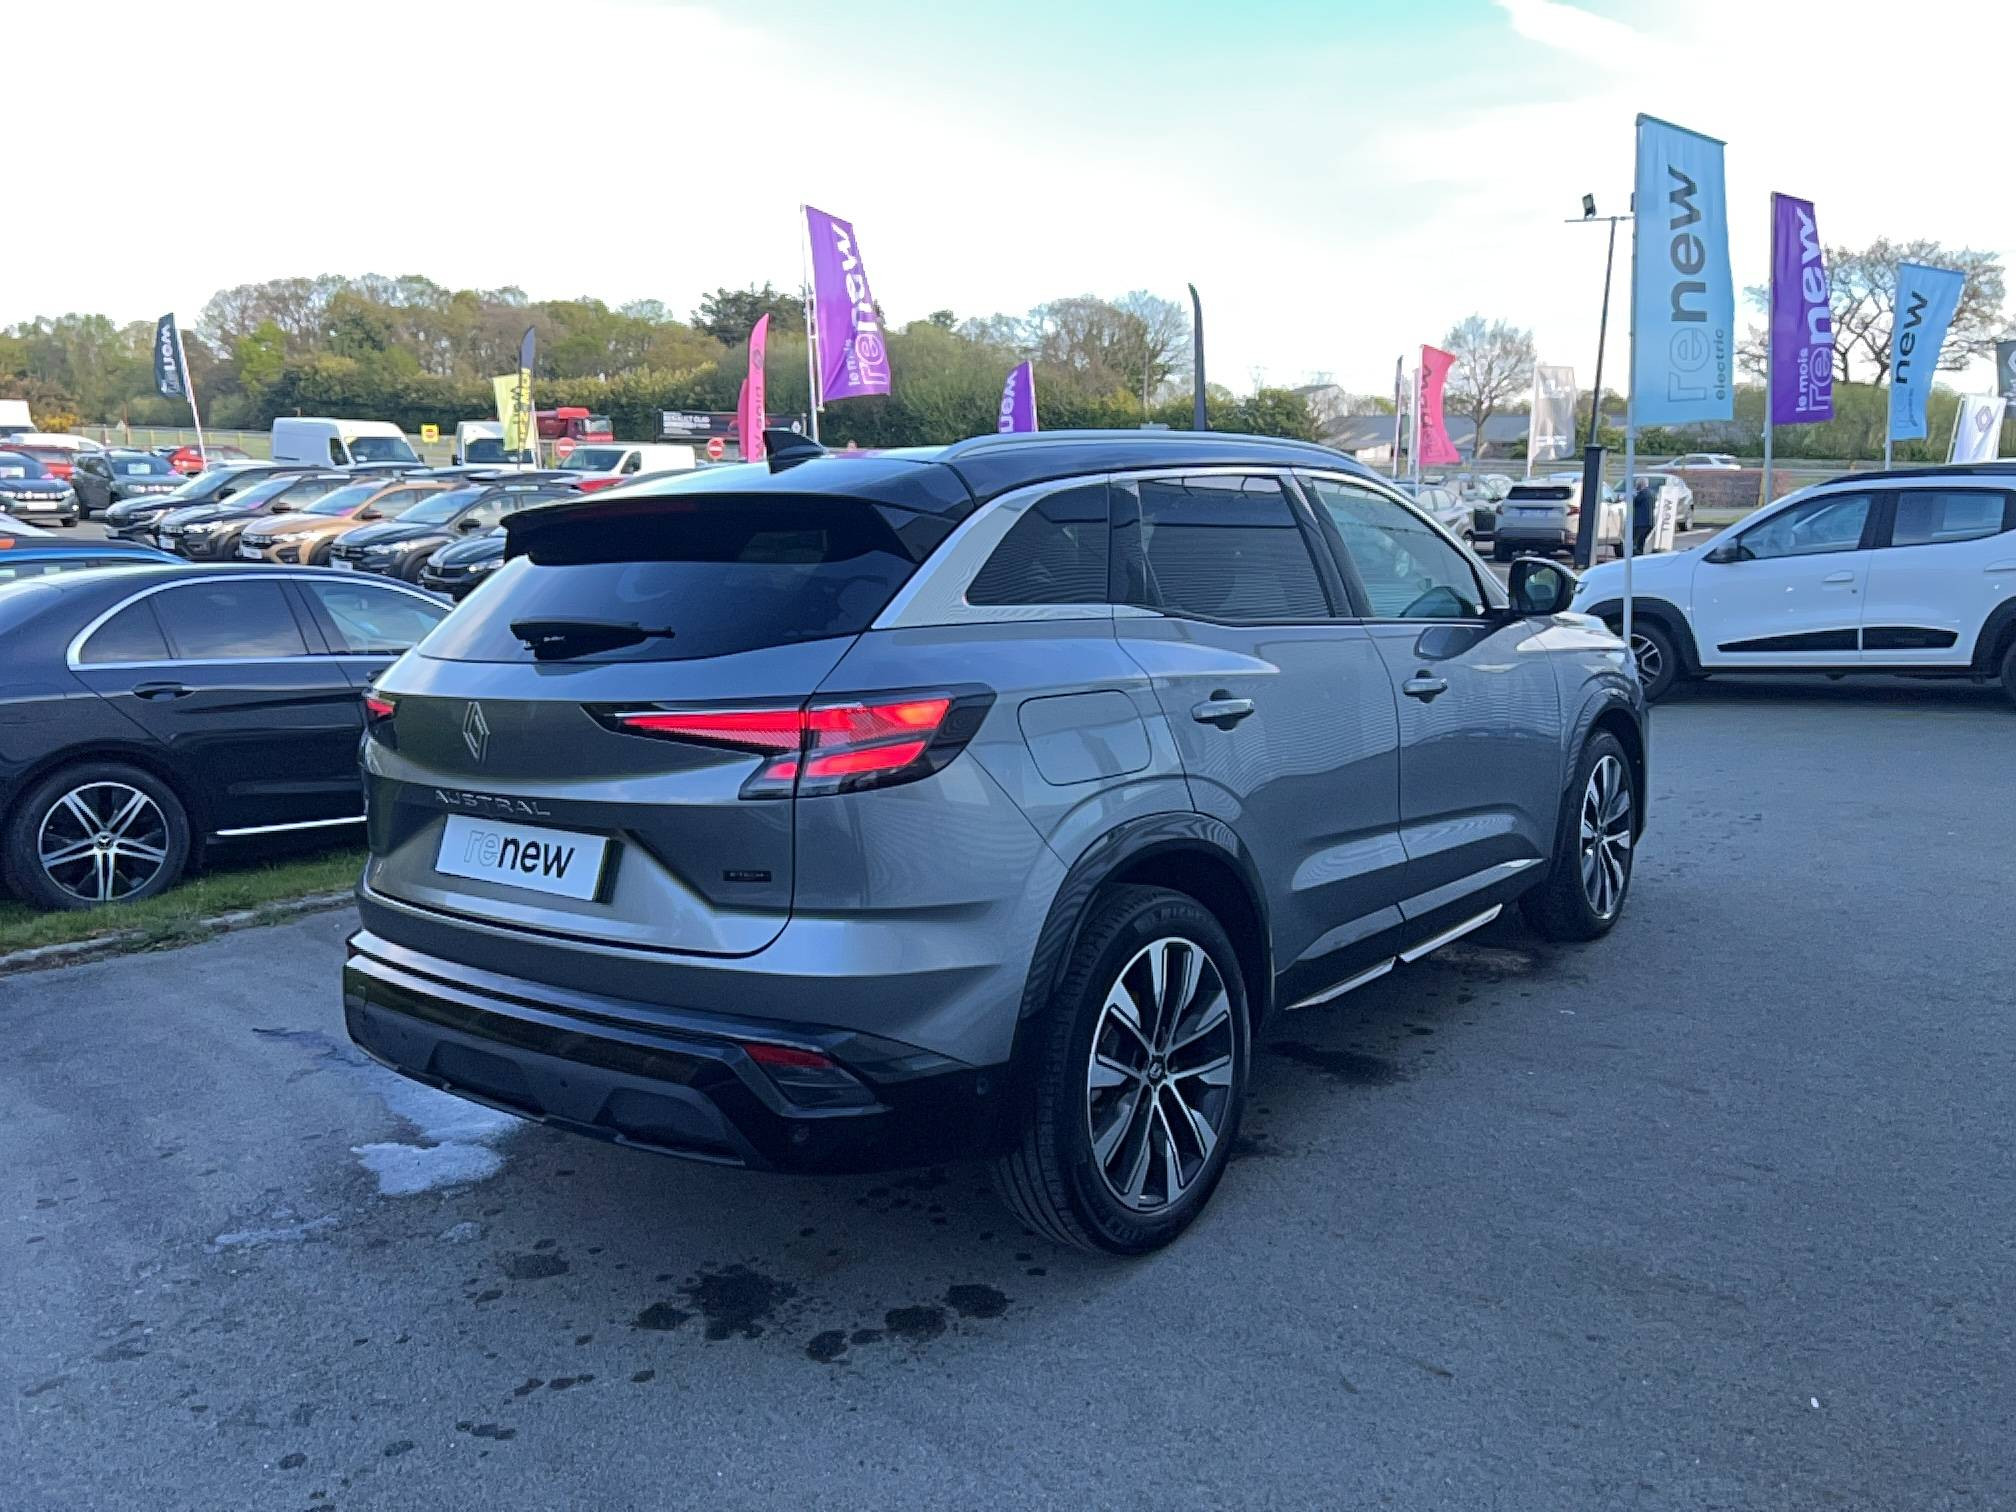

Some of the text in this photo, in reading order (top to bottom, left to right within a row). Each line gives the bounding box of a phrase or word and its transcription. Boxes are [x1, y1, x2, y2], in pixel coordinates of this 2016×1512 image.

[831, 221, 888, 385] renew
[1667, 164, 1711, 402] renew
[1796, 206, 1835, 411] renew
[1713, 328, 1725, 401] electric
[1796, 347, 1809, 411] le mois
[435, 789, 551, 816] AUSTRAL
[463, 829, 576, 879] renew
